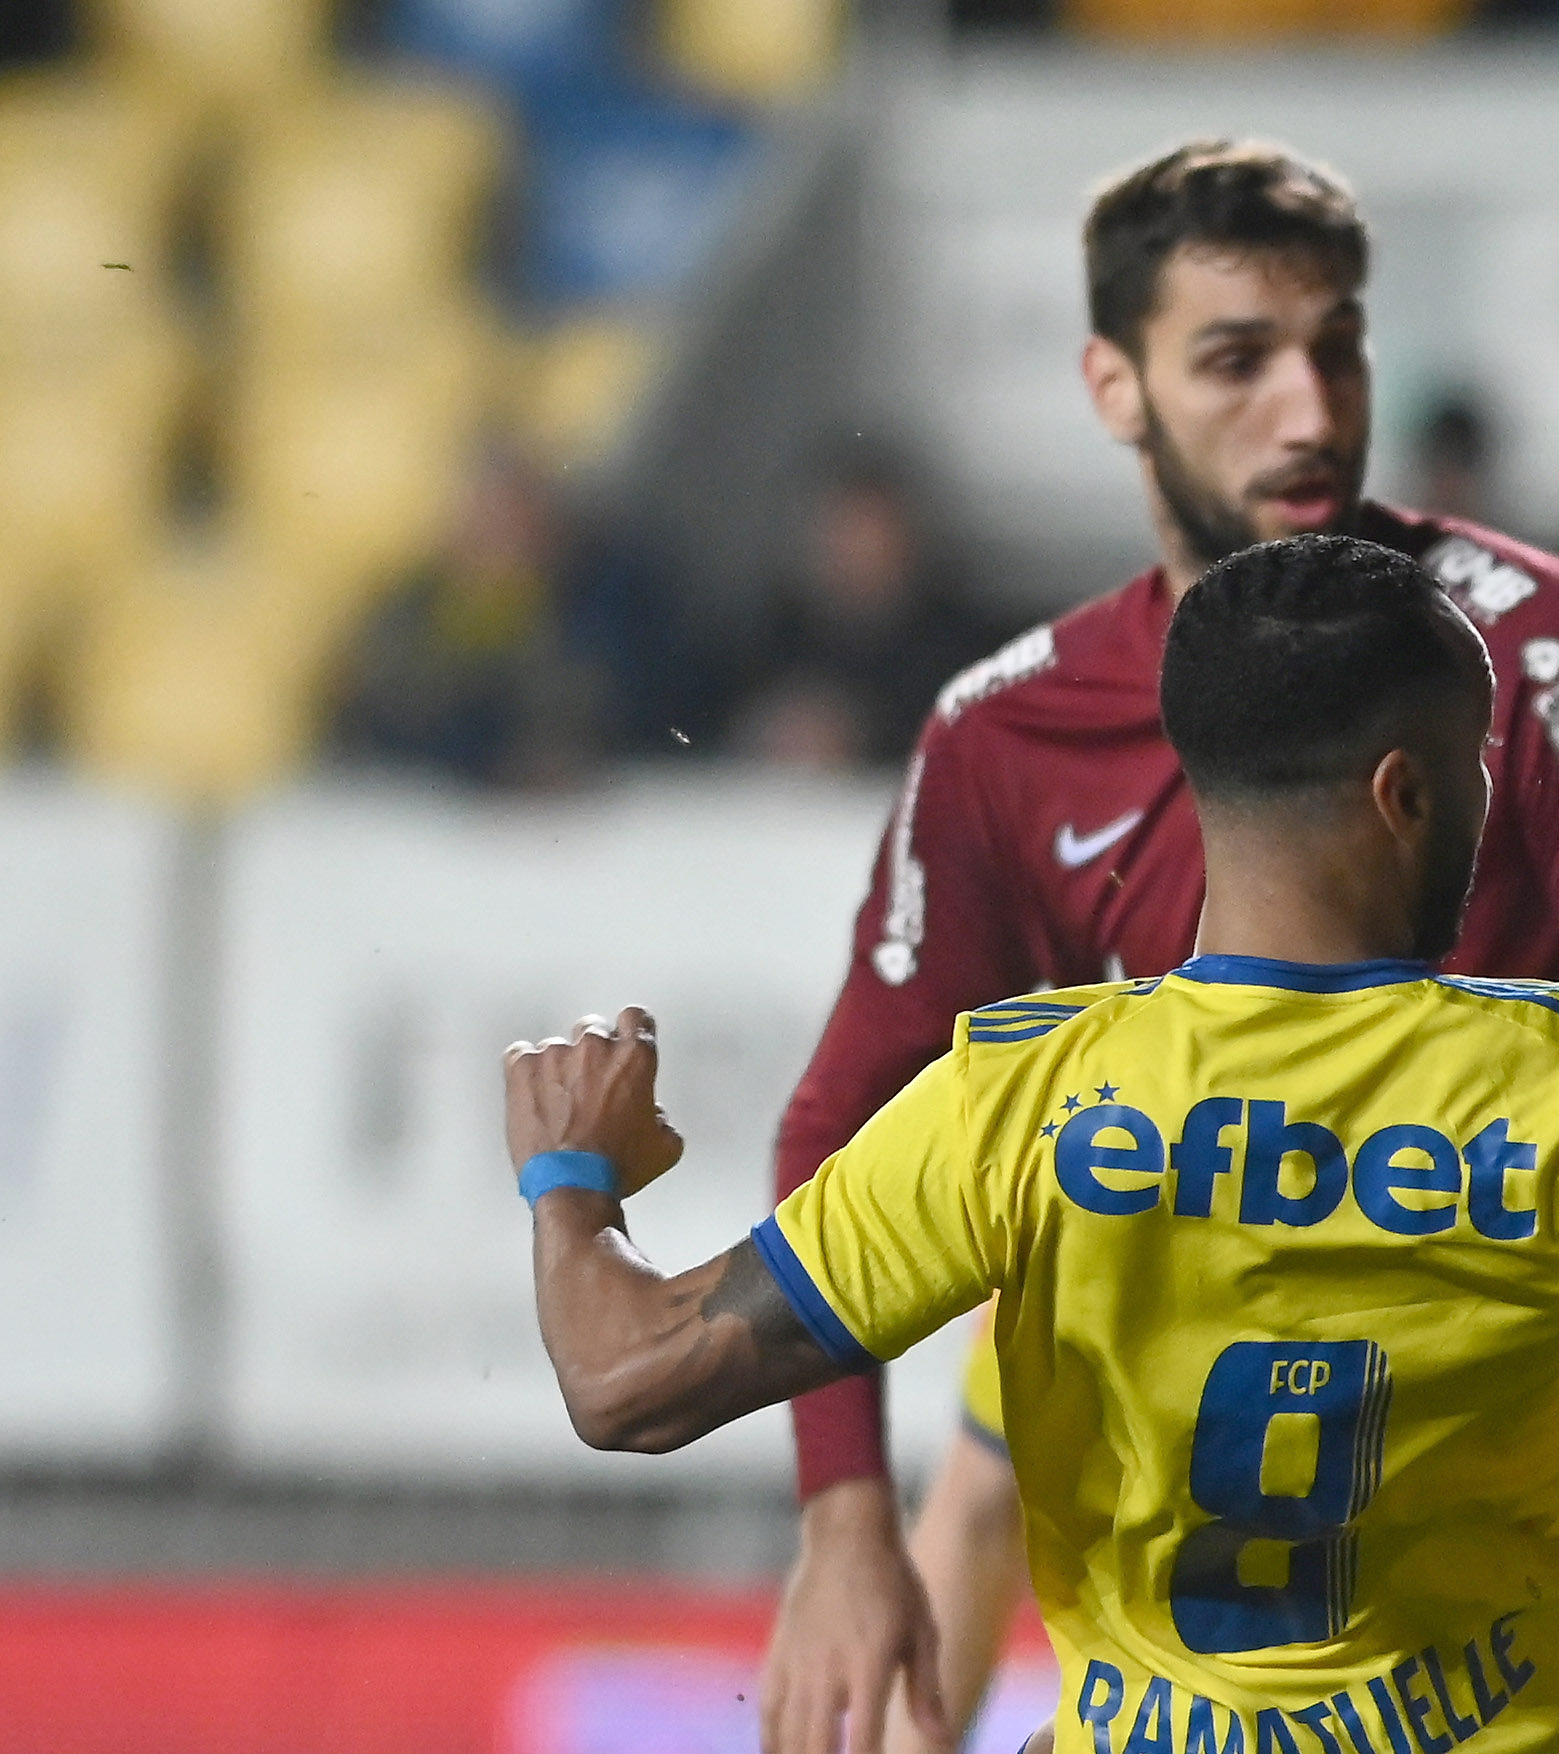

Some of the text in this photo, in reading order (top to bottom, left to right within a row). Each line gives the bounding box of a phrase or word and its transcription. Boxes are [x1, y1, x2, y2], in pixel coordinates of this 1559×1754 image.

[1054, 1097, 1537, 1241] efbet
[1270, 1360, 1331, 1395] FCP
[1170, 1340, 1391, 1654] 8
